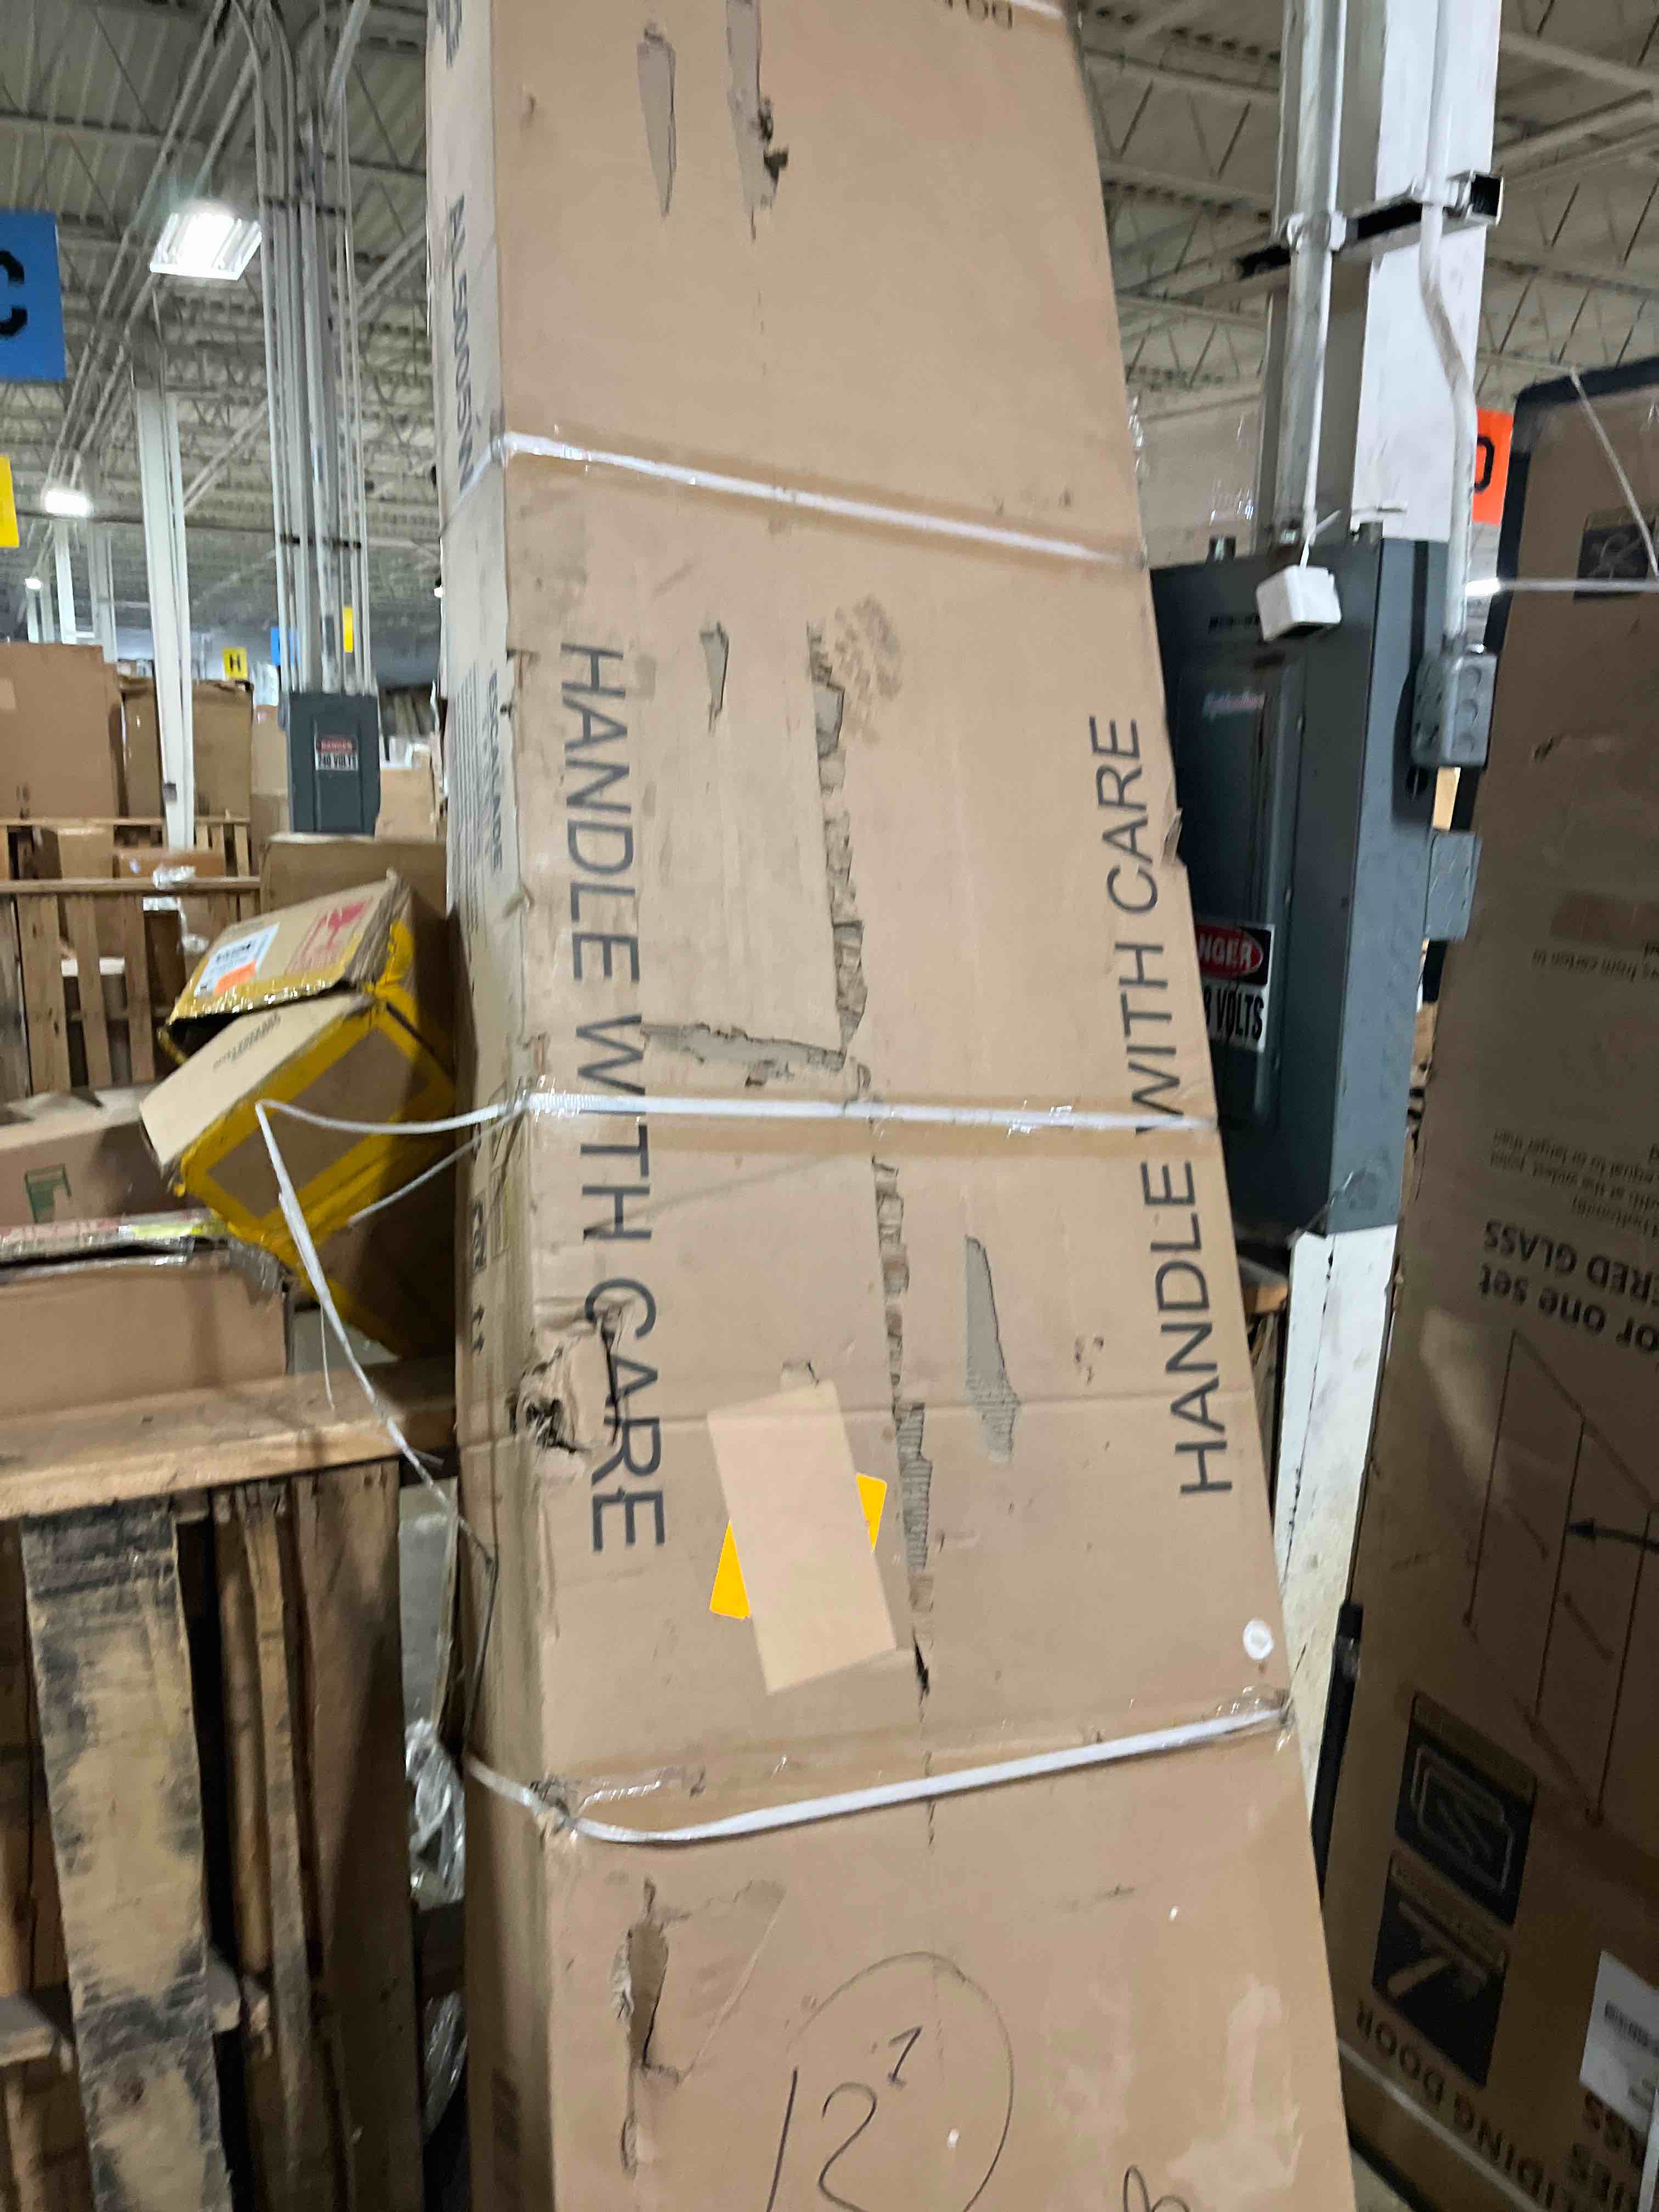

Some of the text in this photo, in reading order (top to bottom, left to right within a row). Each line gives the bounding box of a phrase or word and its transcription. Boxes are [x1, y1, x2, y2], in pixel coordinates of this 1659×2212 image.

[228, 653, 241, 672] H
[560, 642, 640, 982] HANDLE
[1199, 933, 1253, 967] NGER
[1217, 989, 1264, 1040] VOLTS
[1089, 715, 1233, 1494] HANDLE WITH CARE
[1485, 1220, 1578, 1278] GLASS
[1479, 1263, 1529, 1306] set
[1538, 1288, 1606, 1336] one
[584, 1278, 665, 1552] CARE
[1356, 2000, 1446, 2107] DOOR
